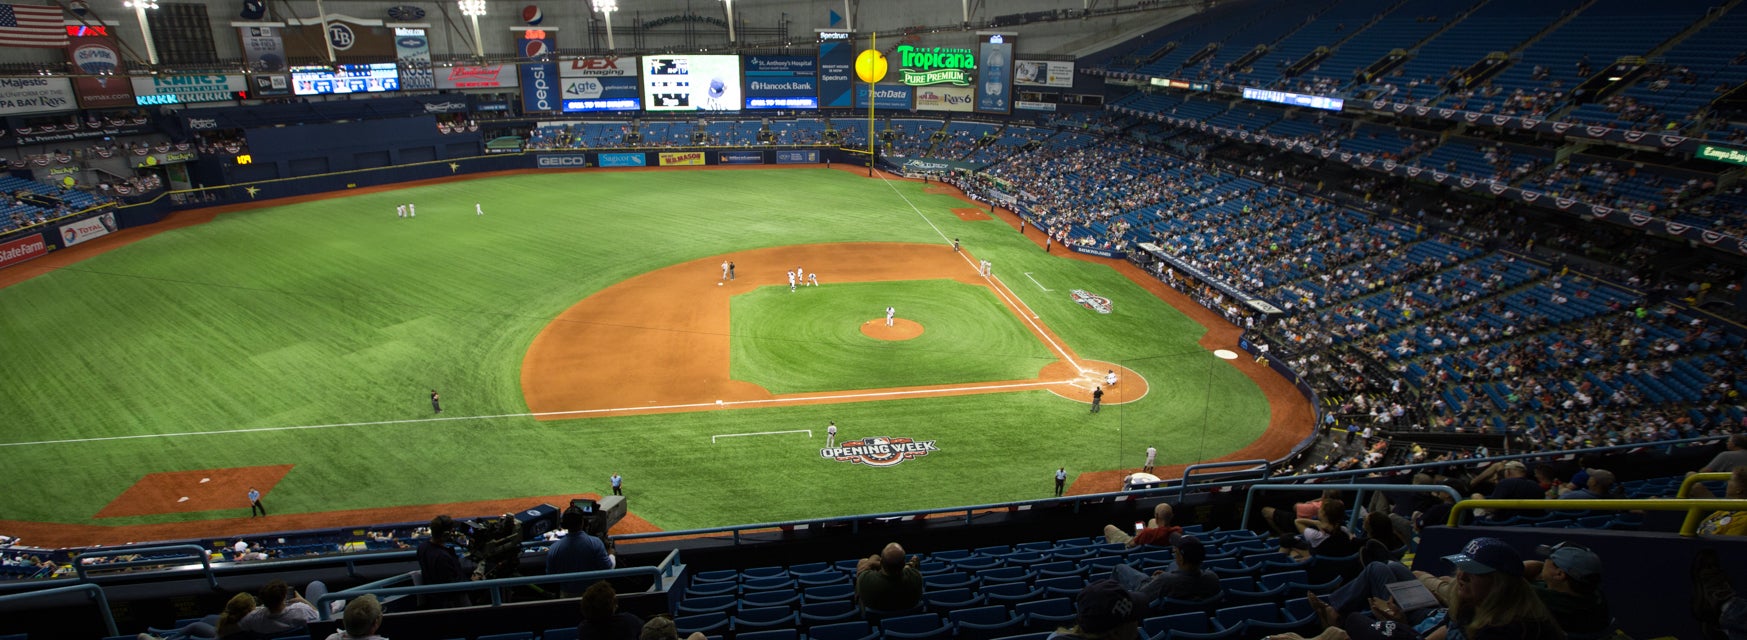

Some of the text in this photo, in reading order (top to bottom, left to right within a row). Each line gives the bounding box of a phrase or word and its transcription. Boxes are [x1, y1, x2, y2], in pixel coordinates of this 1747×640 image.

[643, 14, 704, 29] TROPICANA
[329, 28, 350, 45] TB
[571, 57, 619, 70] DEX
[897, 45, 975, 70] Tropicana
[2, 78, 48, 88] Majestic
[905, 72, 964, 83] PURE PREMIUM
[530, 65, 551, 110] pepsi
[578, 81, 597, 93] gte
[760, 82, 791, 90] Hancock
[17, 98, 37, 107] BAY
[40, 95, 66, 107] Rays
[944, 94, 965, 105] Rays
[964, 94, 972, 104] 6
[1704, 146, 1745, 162] Tampa Bay
[540, 157, 583, 166] GEICO
[79, 223, 102, 234] TOTAL
[822, 440, 935, 457] OPENING WEEK
